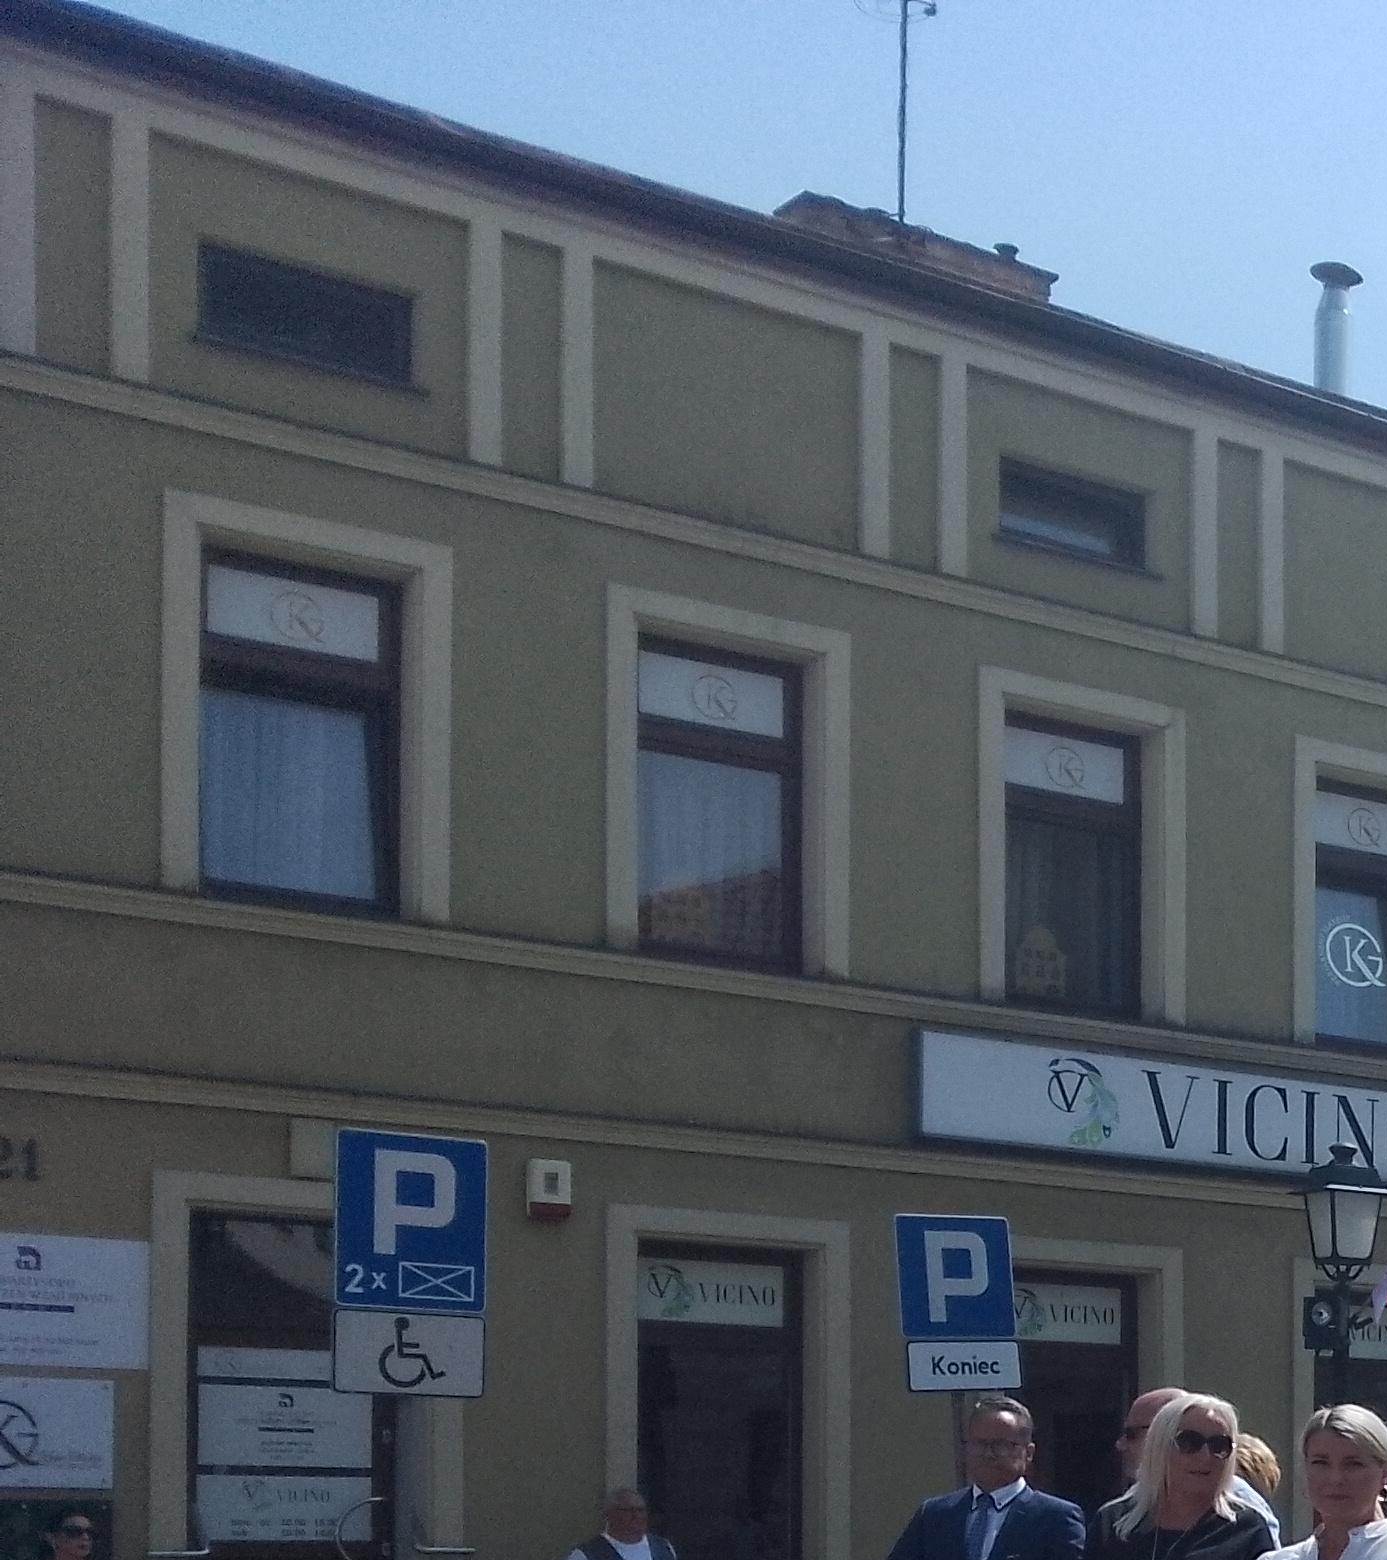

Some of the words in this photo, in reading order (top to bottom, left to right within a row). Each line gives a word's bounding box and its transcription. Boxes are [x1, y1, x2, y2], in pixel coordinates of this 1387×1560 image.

[373, 1148, 457, 1255] P
[924, 1229, 989, 1323] P
[699, 1282, 776, 1306] VICINO
[1050, 1303, 1115, 1325] VICINO
[932, 1355, 1001, 1376] Koniec
